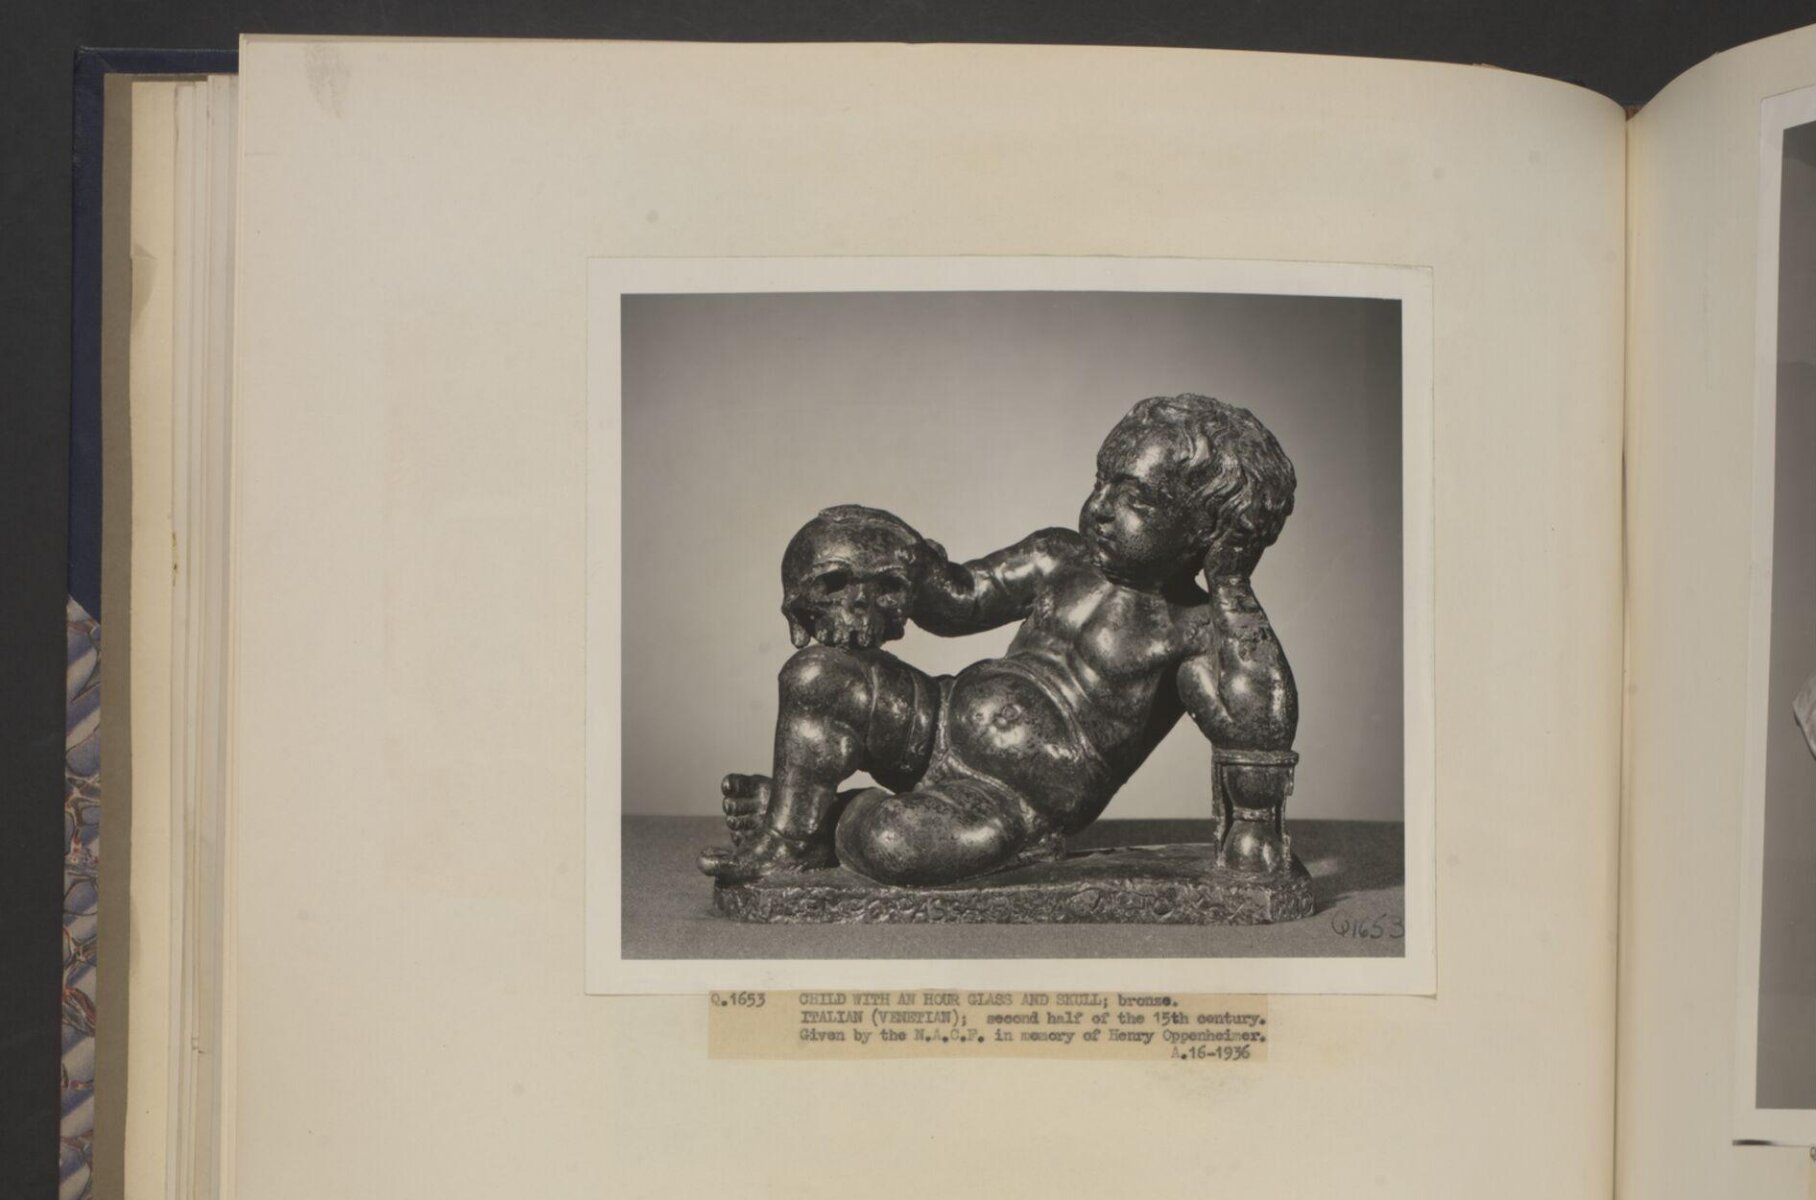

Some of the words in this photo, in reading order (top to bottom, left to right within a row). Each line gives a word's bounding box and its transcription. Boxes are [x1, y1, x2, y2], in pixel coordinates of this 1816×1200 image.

[710, 991, 766, 1008] Q.1653
[799, 993, 847, 1006] CHILD
[852, 993, 891, 1006] WITH
[897, 993, 915, 1006] AN
[923, 993, 960, 1006] HOUR
[967, 993, 1013, 1006] GLASS
[1021, 993, 1049, 1006] AND
[1056, 993, 1109, 1009] SKULL;
[1117, 994, 1179, 1007] bronze.
[800, 1010, 864, 1024] ITALIAN
[871, 1009, 967, 1027] (VENETIAN);
[986, 1012, 1040, 1024] second
[1047, 1012, 1084, 1024] half
[1091, 1012, 1110, 1024] of
[1117, 1012, 1145, 1024] the
[1153, 1011, 1189, 1026] 15th
[1196, 1012, 1266, 1027] century.
[799, 1028, 846, 1041] Given
[853, 1028, 872, 1044] by
[879, 1029, 906, 1041] the
[914, 1029, 985, 1043] N.A.C.F.
[994, 1029, 1013, 1041] in
[1020, 1030, 1076, 1044] memory
[1083, 1029, 1102, 1041] of
[1109, 1029, 1154, 1045] Henry
[1163, 1029, 1267, 1045] Oppenheimer.
[1171, 1044, 1251, 1061] A.16-1936
